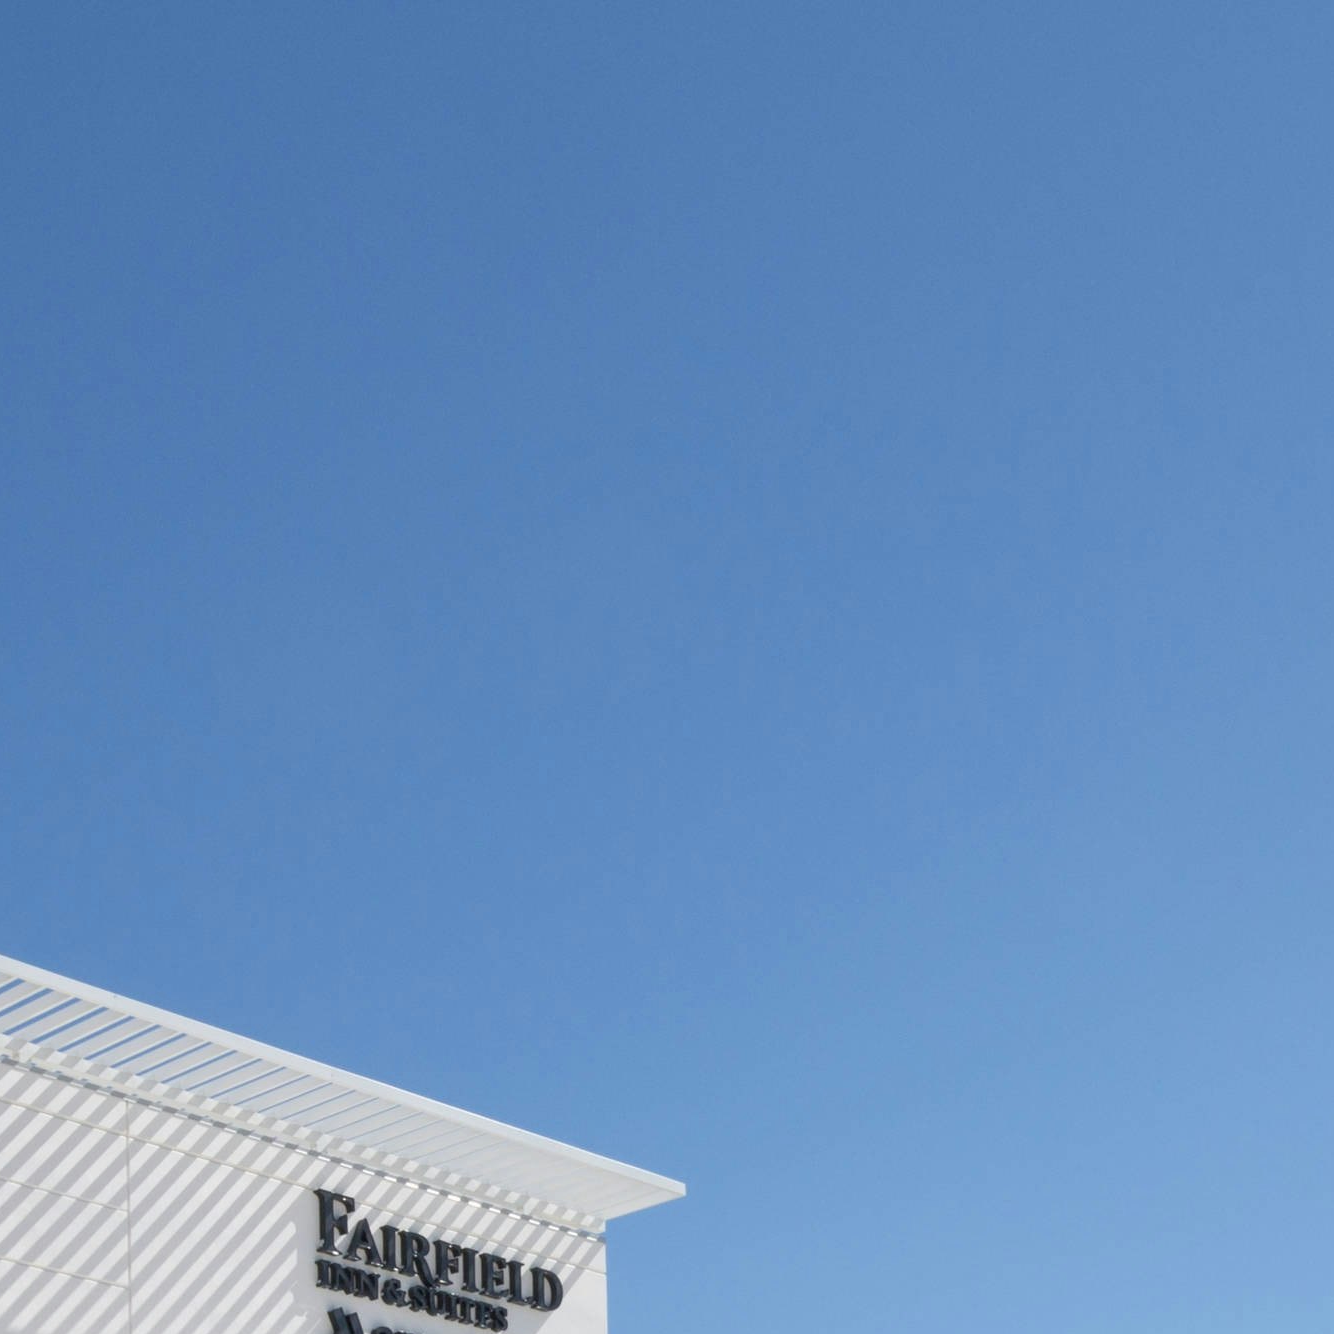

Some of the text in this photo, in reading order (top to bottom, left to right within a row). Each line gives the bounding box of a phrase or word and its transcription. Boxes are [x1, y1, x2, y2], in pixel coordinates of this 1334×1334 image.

[315, 1259, 509, 1332] INN & SUITES
